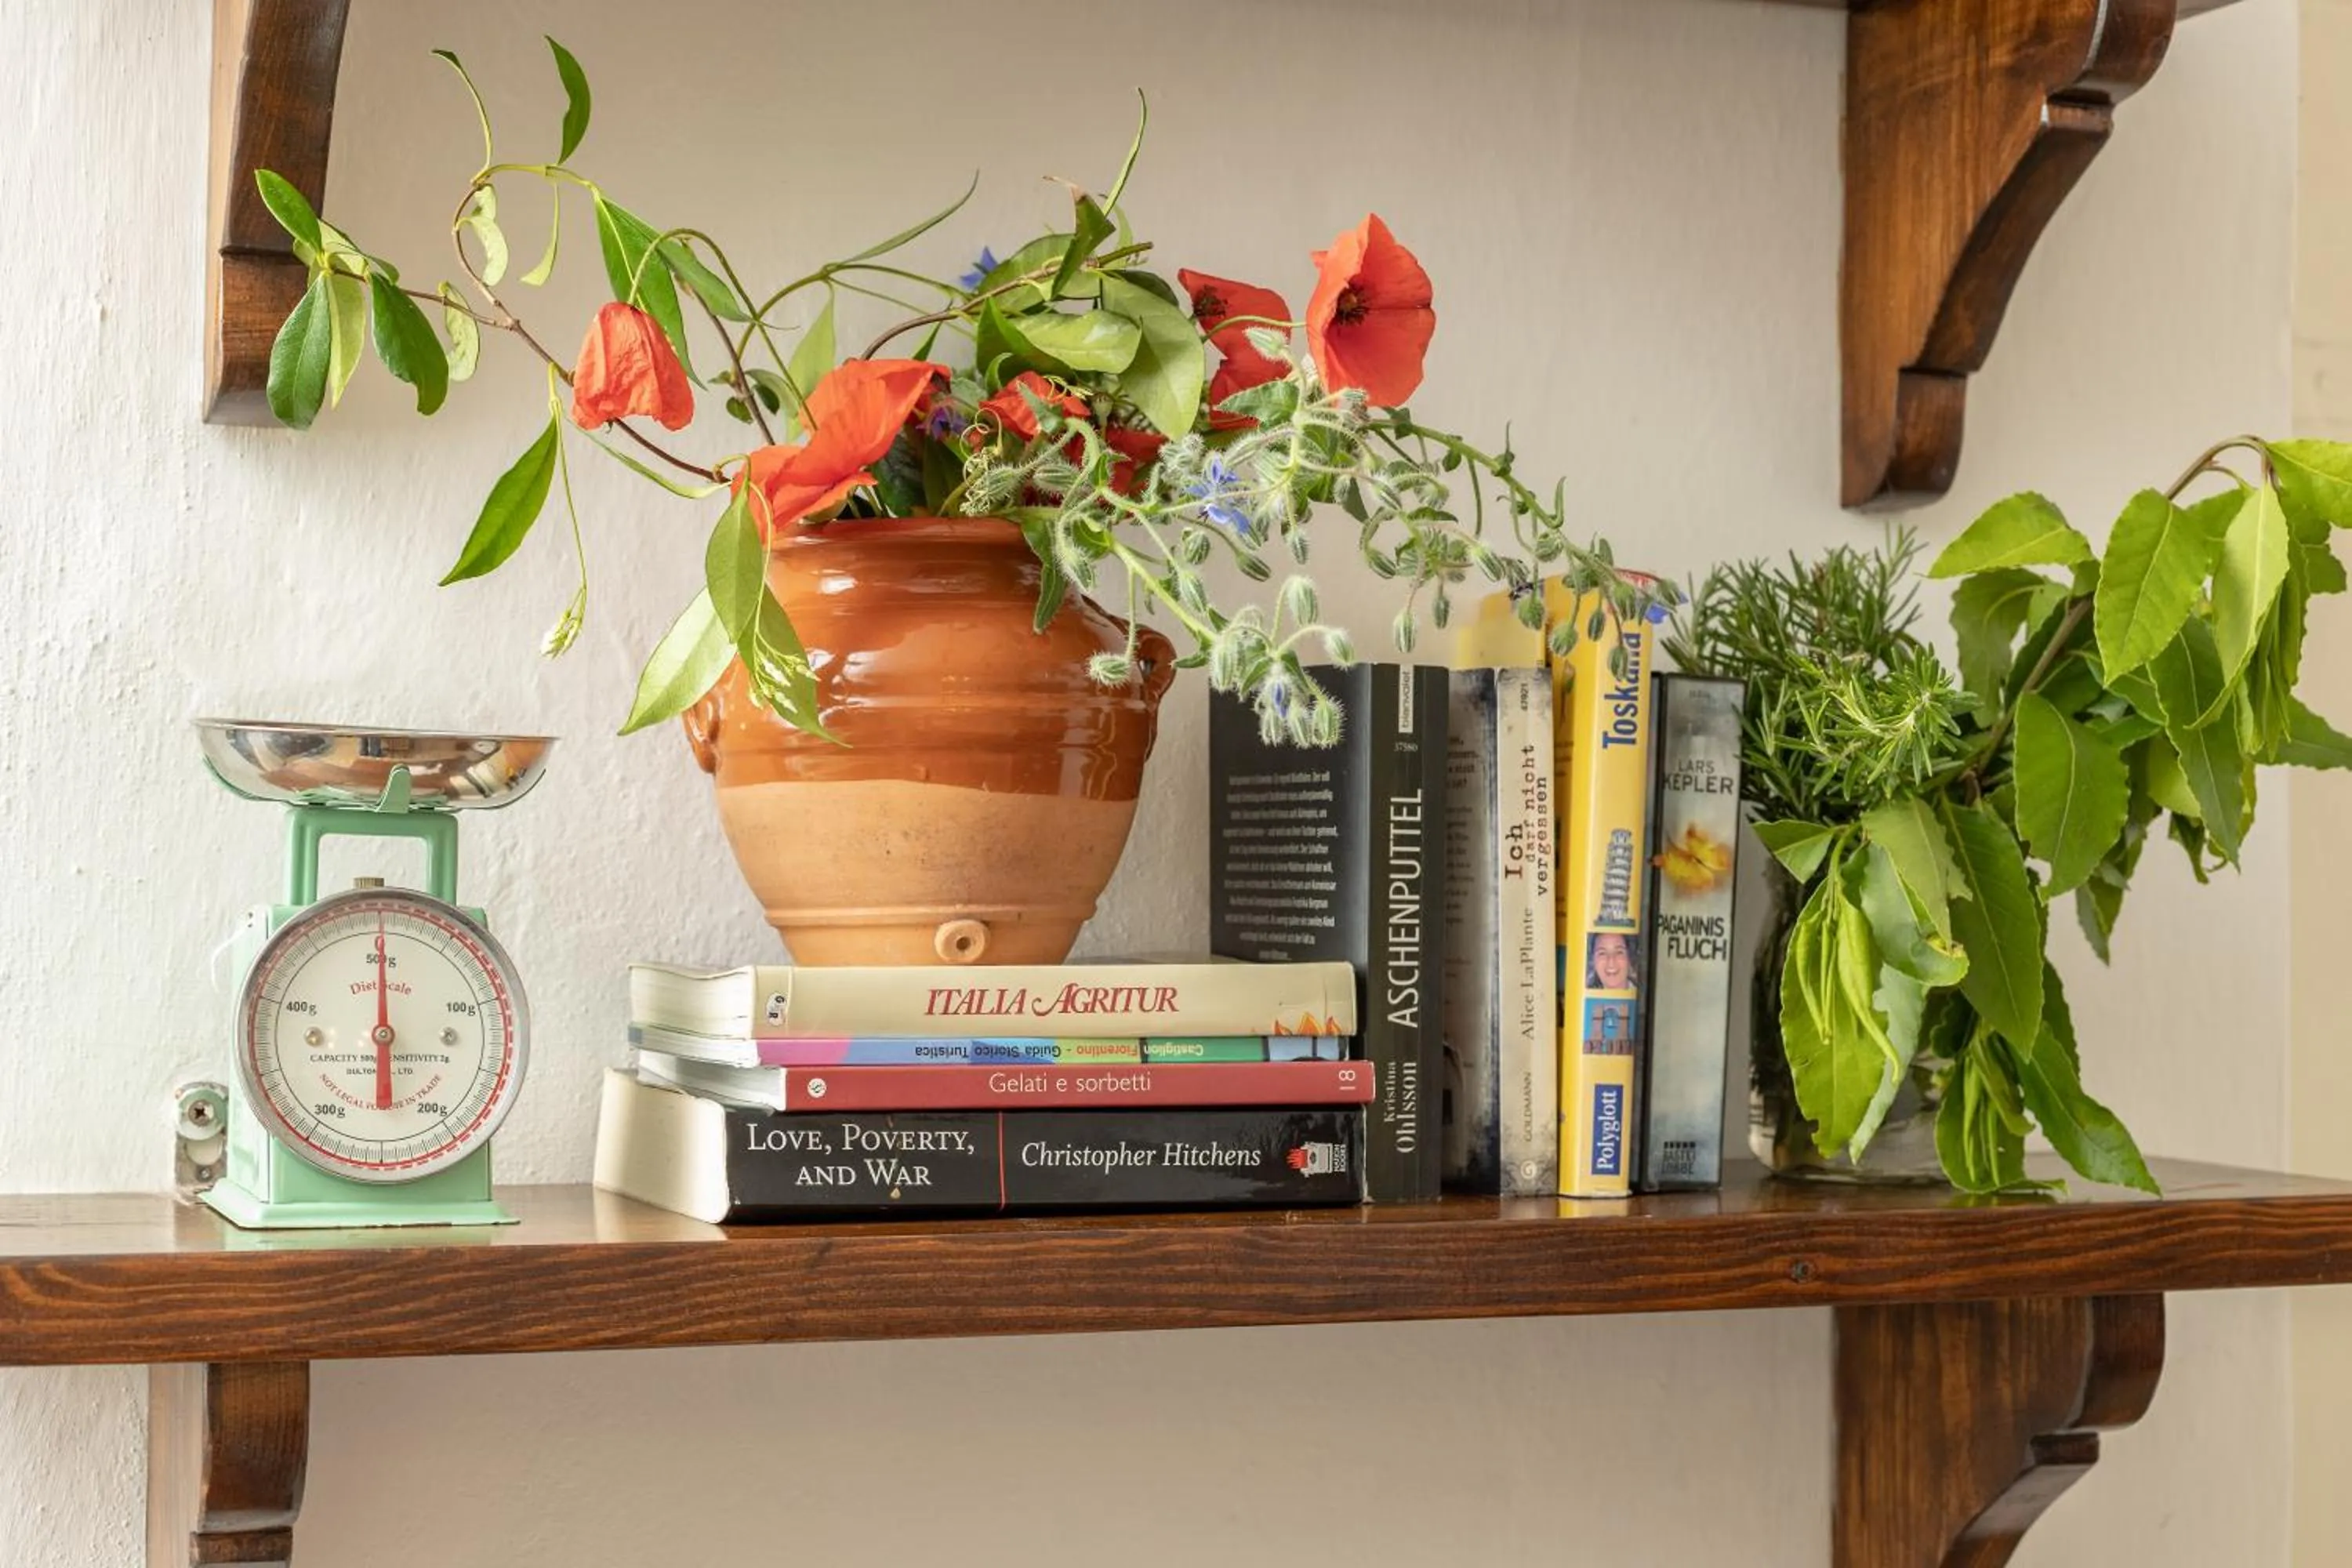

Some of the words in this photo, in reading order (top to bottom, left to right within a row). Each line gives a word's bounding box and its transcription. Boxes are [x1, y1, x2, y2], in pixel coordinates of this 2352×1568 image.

[1520, 744, 1535, 811] nicht
[1679, 759, 1715, 775] LARS
[1662, 772, 1734, 795] KEPLER
[1523, 818, 1536, 863] darf
[1535, 776, 1552, 897] vergessen
[1504, 823, 1524, 880] Ich
[1387, 788, 1423, 1029] ASCHENPUTTEL
[1657, 914, 1724, 937] PAGANINIS
[1519, 907, 1535, 989] LaPlante
[1668, 937, 1727, 961] FLUCH
[350, 981, 377, 995] Diet
[384, 982, 412, 996] cale
[924, 988, 1027, 1016] ITALIA
[1031, 982, 1179, 1017] AGRITUR
[1519, 994, 1535, 1040] Alice
[310, 1054, 358, 1062] CAPACITY
[914, 1045, 970, 1059] Turistica
[975, 1045, 1021, 1058] Storico
[1024, 1044, 1062, 1058] Guida
[1076, 1044, 1138, 1056] Fiorentino
[416, 1073, 441, 1098] TRADE
[989, 1072, 1048, 1093] Gelati
[1055, 1077, 1068, 1092] e
[1075, 1071, 1152, 1092] sorbetti
[1338, 1069, 1356, 1091] 18
[1383, 1061, 1397, 1123] Kristina
[1396, 1061, 1418, 1154] Ohlsson
[1523, 1071, 1533, 1143] GOLDMANN
[1596, 1090, 1621, 1171] Polyglott
[1021, 1141, 1156, 1174] Christopher
[1161, 1142, 1261, 1167] Hitchens
